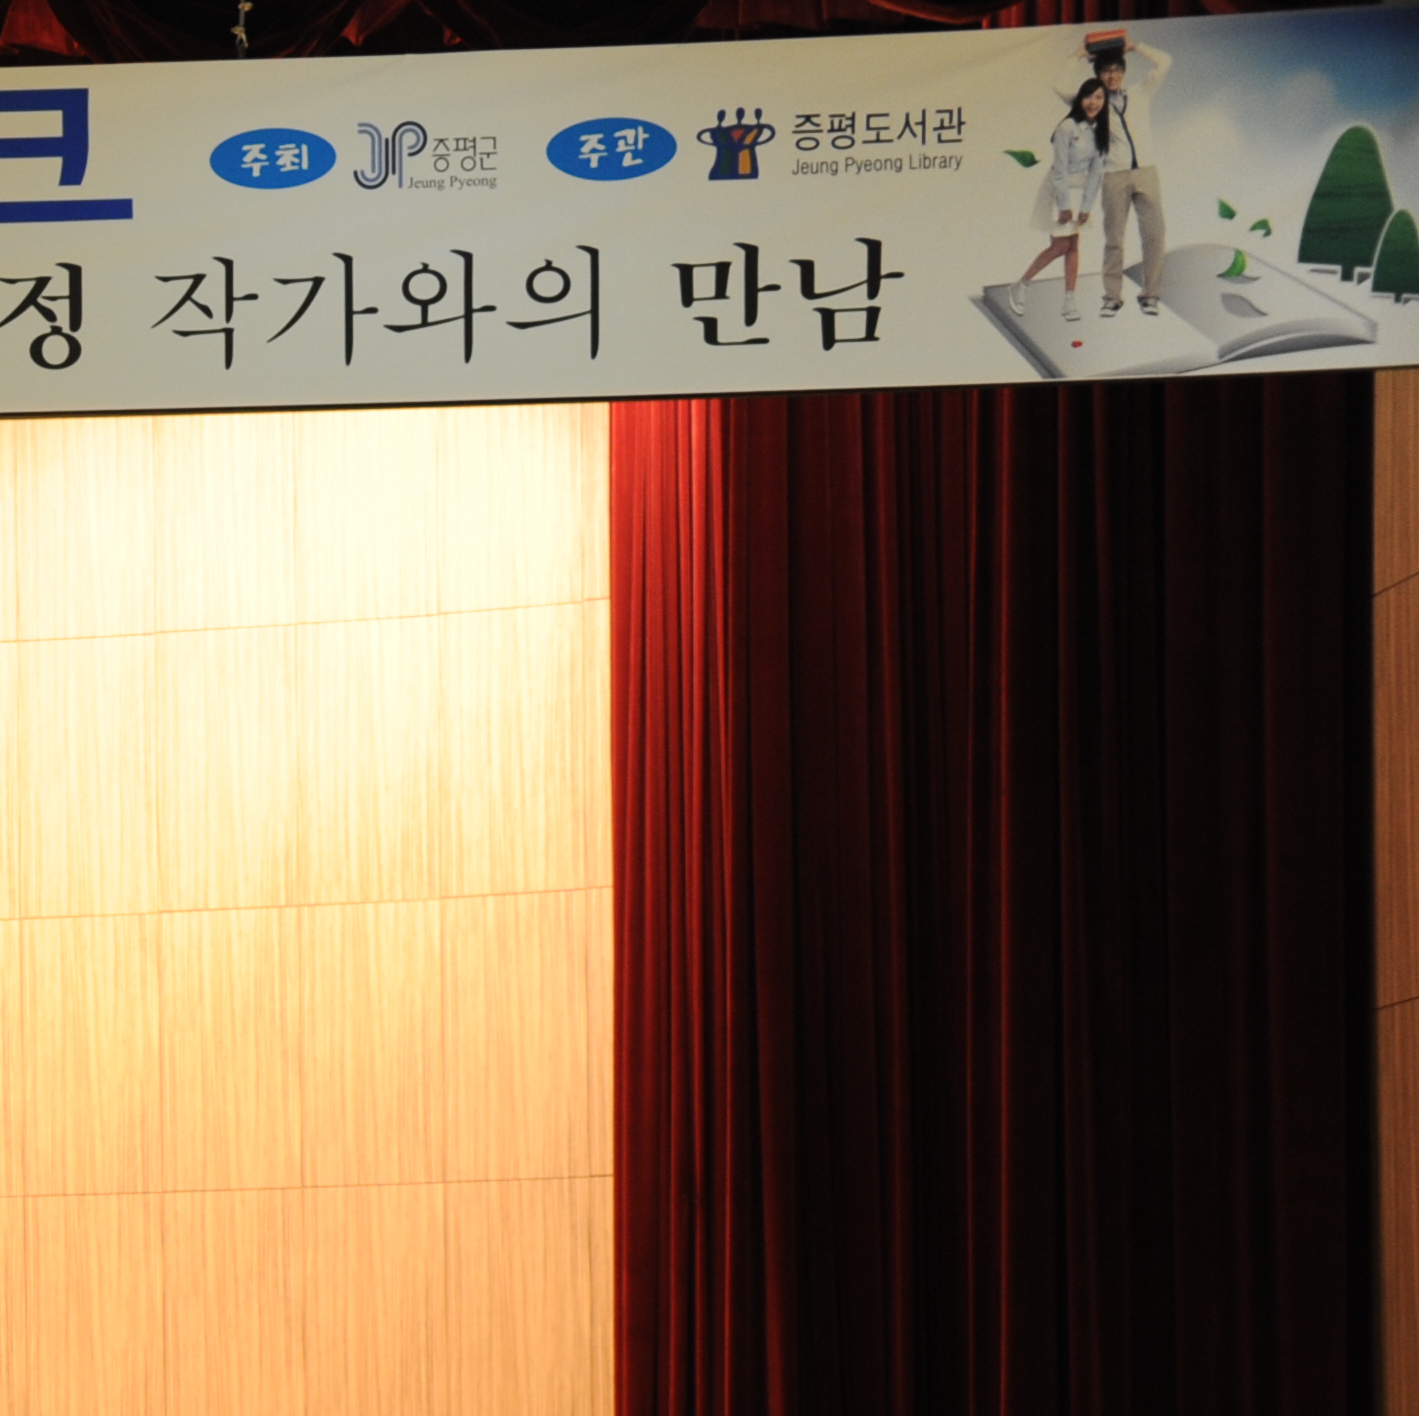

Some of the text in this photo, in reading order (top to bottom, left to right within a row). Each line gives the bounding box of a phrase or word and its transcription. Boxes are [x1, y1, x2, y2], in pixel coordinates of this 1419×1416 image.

[578, 126, 650, 168] 주관
[791, 106, 966, 152] 증평도서관
[240, 143, 310, 177] 주최
[431, 136, 498, 173] 증평군
[790, 152, 964, 177] Jeung Pyeong Library
[408, 174, 497, 191] Jeung Pyeong
[149, 244, 602, 371] 작가와의
[671, 237, 906, 352] 만남
